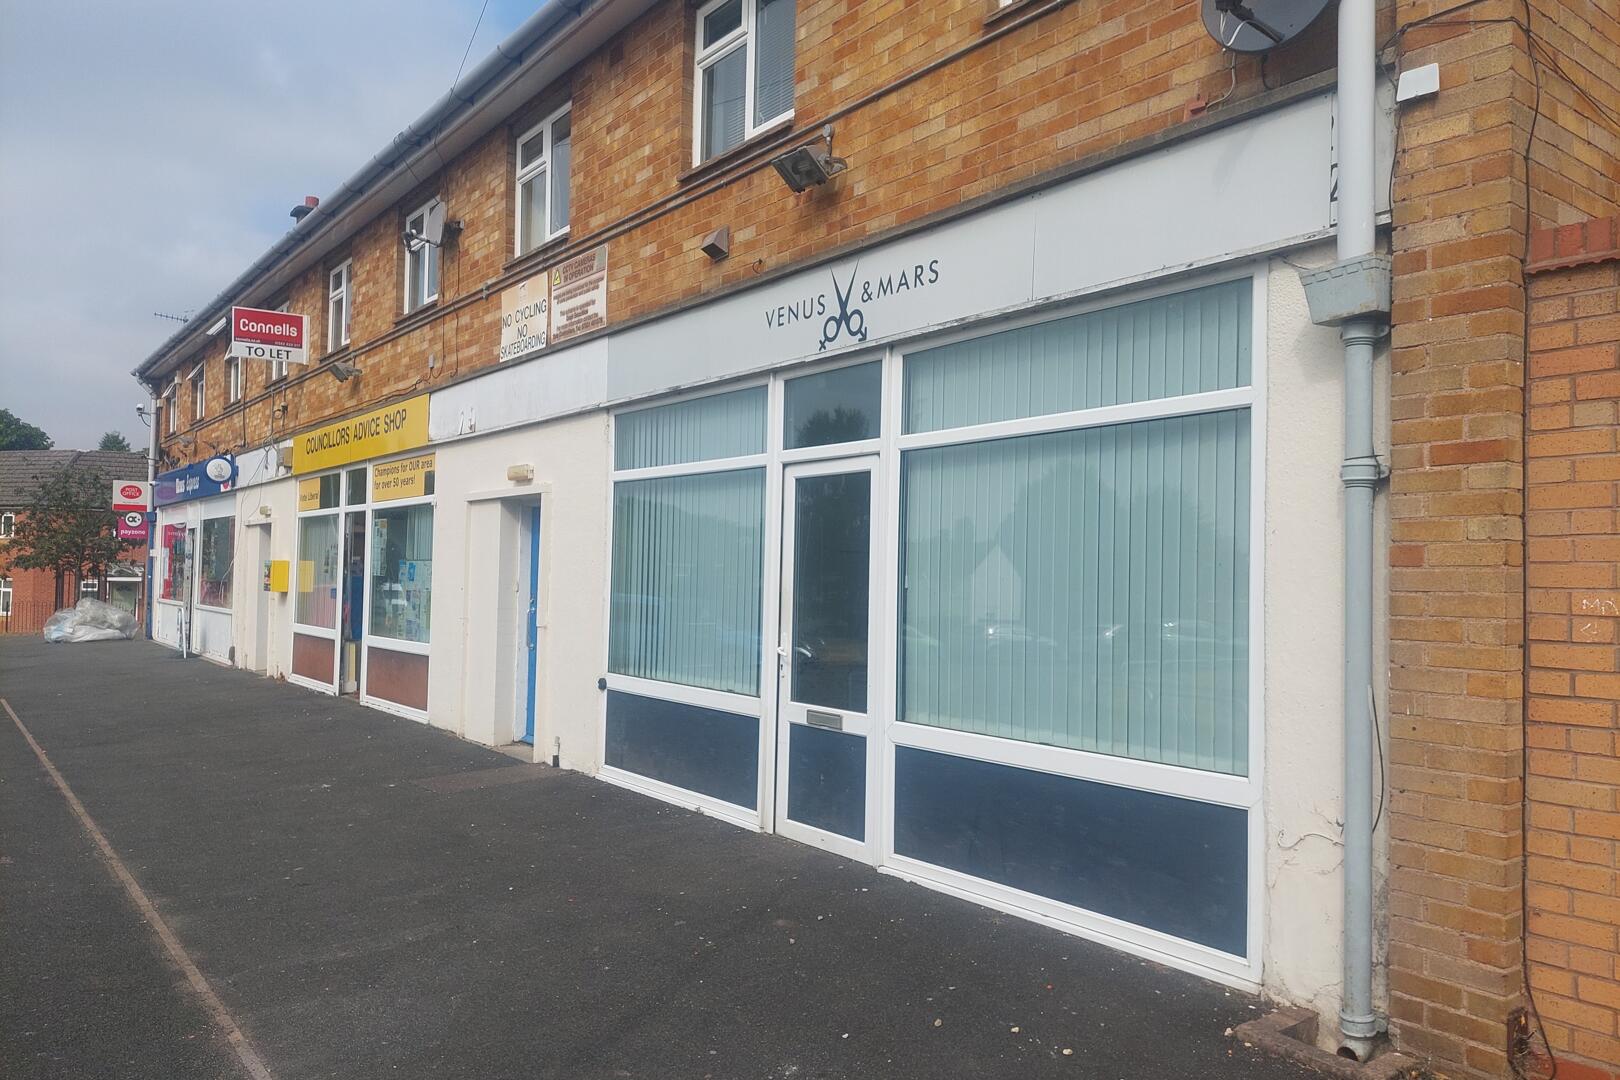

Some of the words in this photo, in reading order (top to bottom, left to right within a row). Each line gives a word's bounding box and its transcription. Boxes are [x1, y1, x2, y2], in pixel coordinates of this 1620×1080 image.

[502, 313, 512, 329] NO
[514, 298, 547, 323] CYCLING
[765, 294, 826, 329] VENUS
[239, 318, 298, 337] Connells
[517, 323, 528, 339] NO
[245, 345, 265, 358] TO
[269, 348, 292, 360] LET
[500, 331, 546, 360] SKATEBOARDING
[306, 426, 350, 455] COUNCILLORS
[353, 416, 380, 440] ADVICE
[384, 408, 407, 434] SHOP
[374, 465, 400, 478] Champions
[400, 462, 408, 473] for
[408, 459, 420, 472] OUR
[420, 459, 433, 470] area
[381, 479, 392, 489] over
[392, 476, 400, 488] 50
[400, 474, 416, 488] years!
